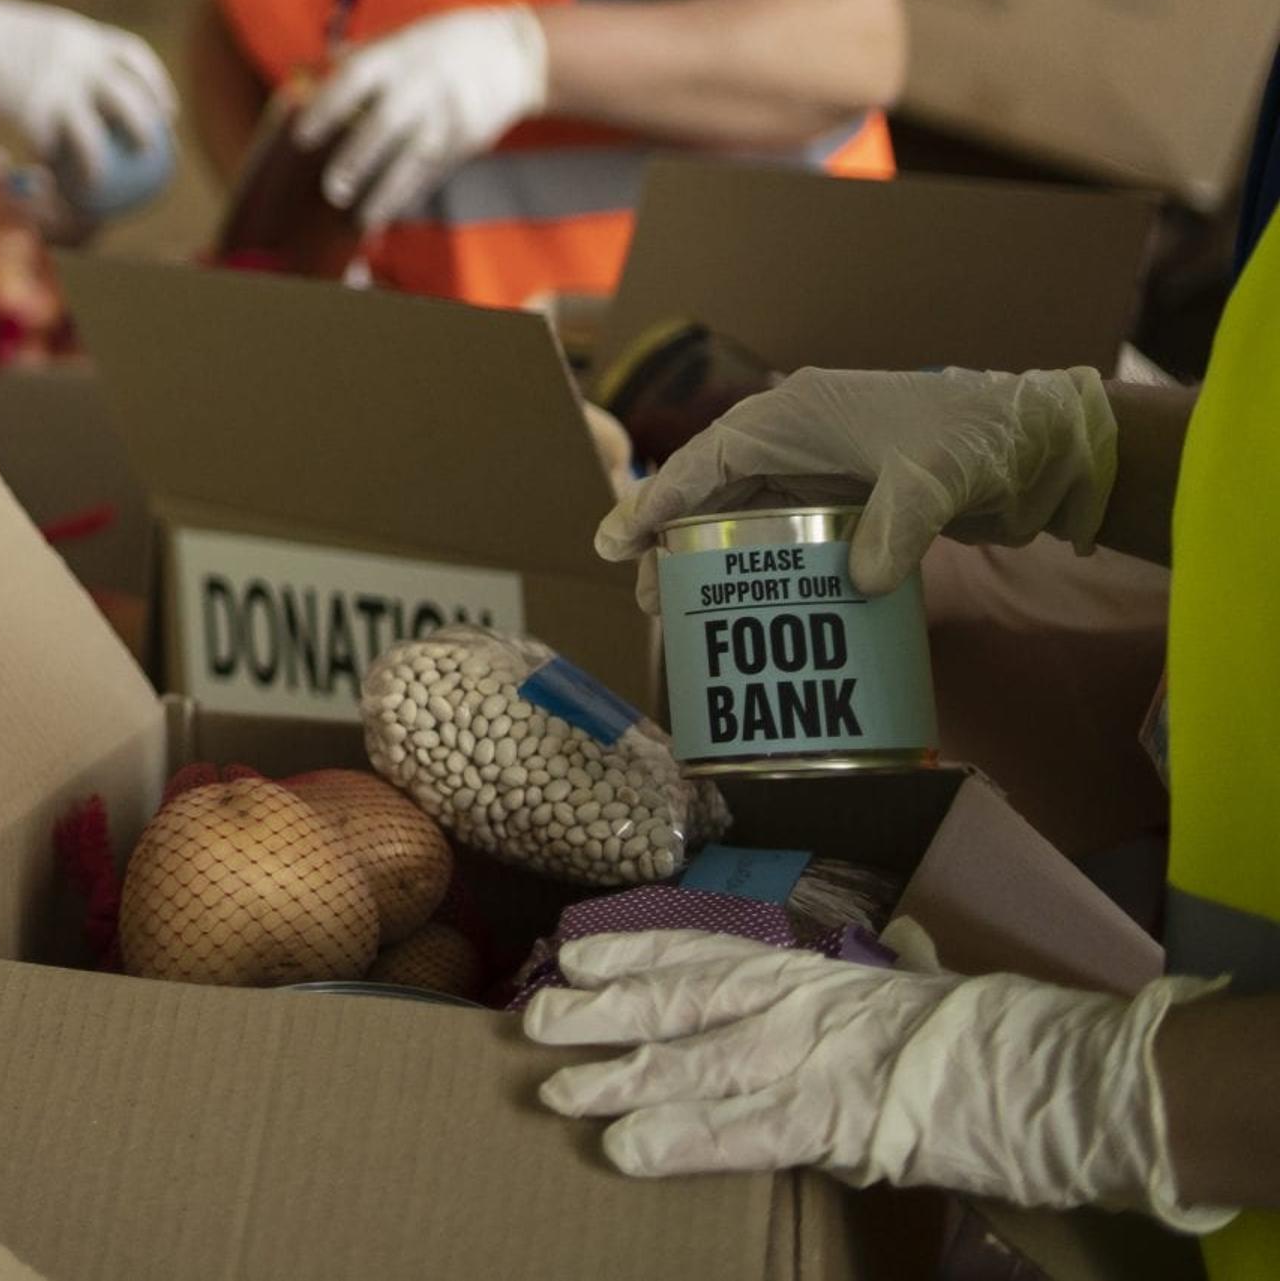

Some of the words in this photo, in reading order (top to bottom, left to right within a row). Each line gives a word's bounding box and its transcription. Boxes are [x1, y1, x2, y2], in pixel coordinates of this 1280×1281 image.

[701, 578, 791, 606] SUPPORT
[798, 576, 842, 598] OUR
[725, 548, 806, 575] PLEASE
[202, 572, 494, 698] DONAT
[704, 612, 848, 677] FOOD
[706, 678, 863, 744] BANK
